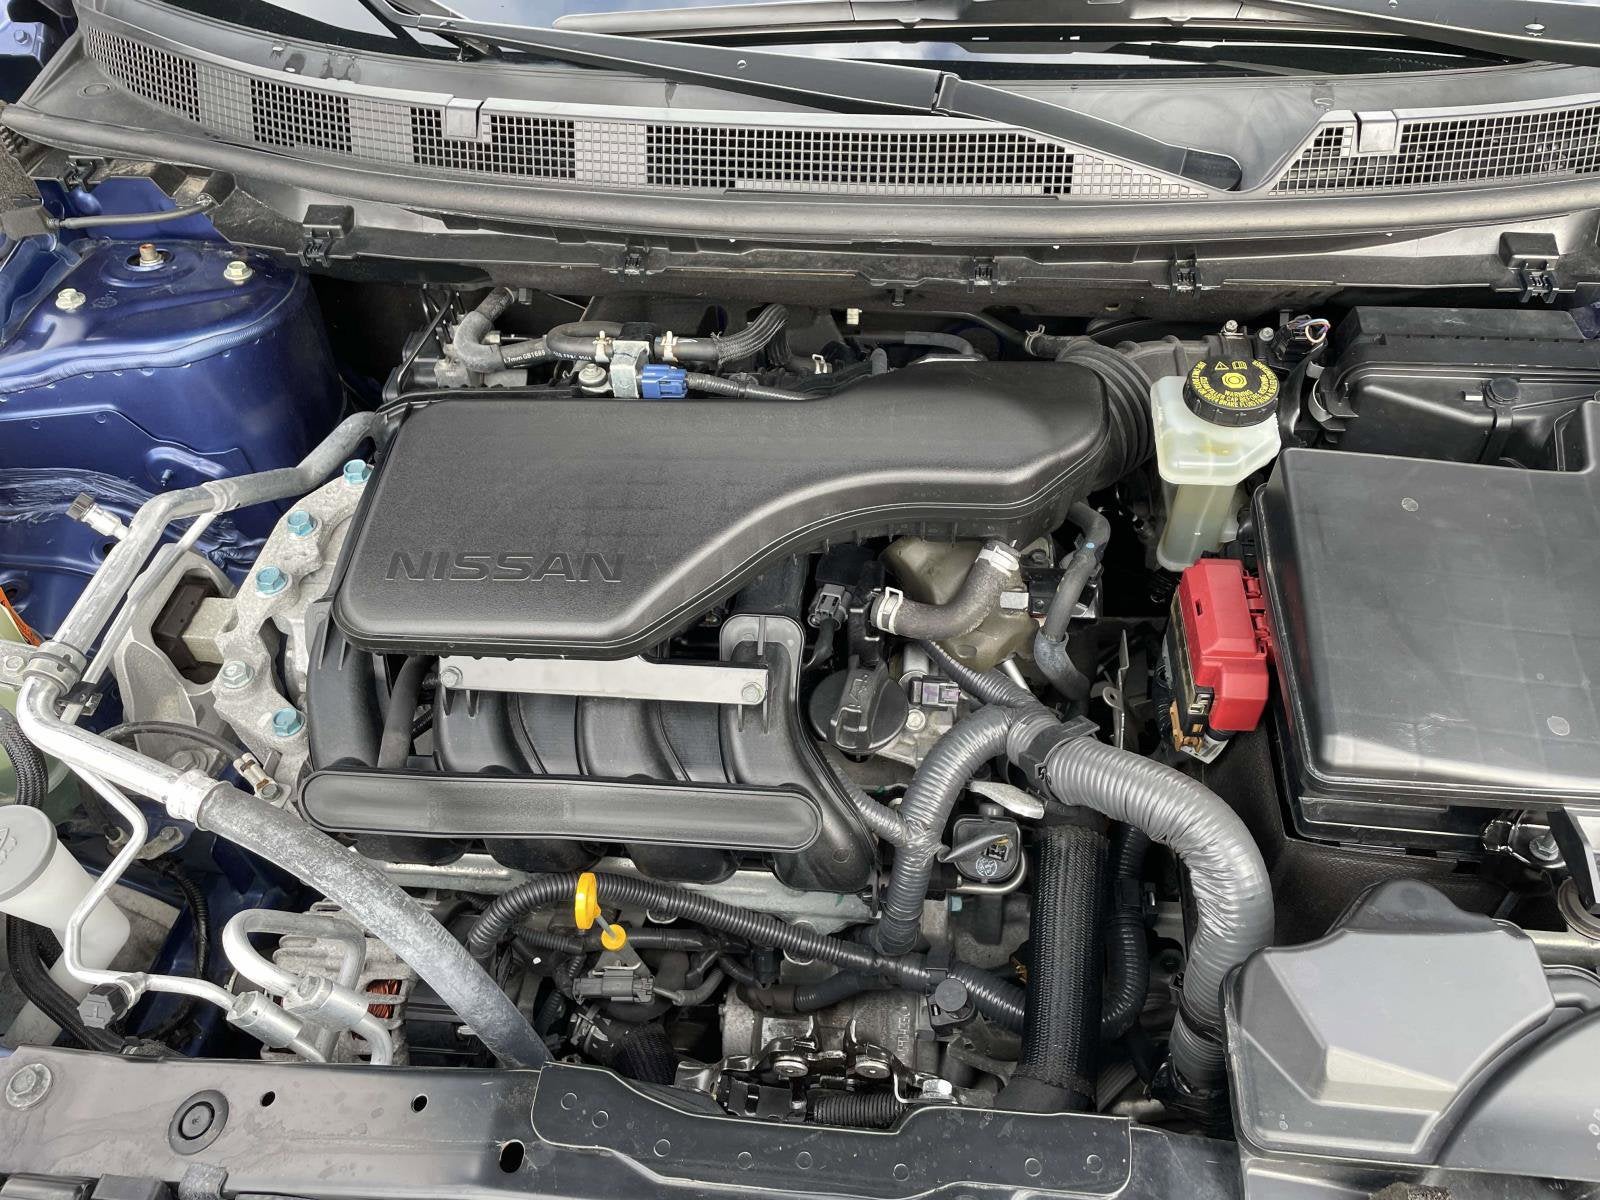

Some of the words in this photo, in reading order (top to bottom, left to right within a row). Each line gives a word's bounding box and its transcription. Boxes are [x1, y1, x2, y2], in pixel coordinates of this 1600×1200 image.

[1224, 389, 1253, 398] WARNING
[1216, 398, 1238, 407] BRAKE
[1238, 399, 1257, 407] FLUID
[385, 551, 625, 583] NISSAN
